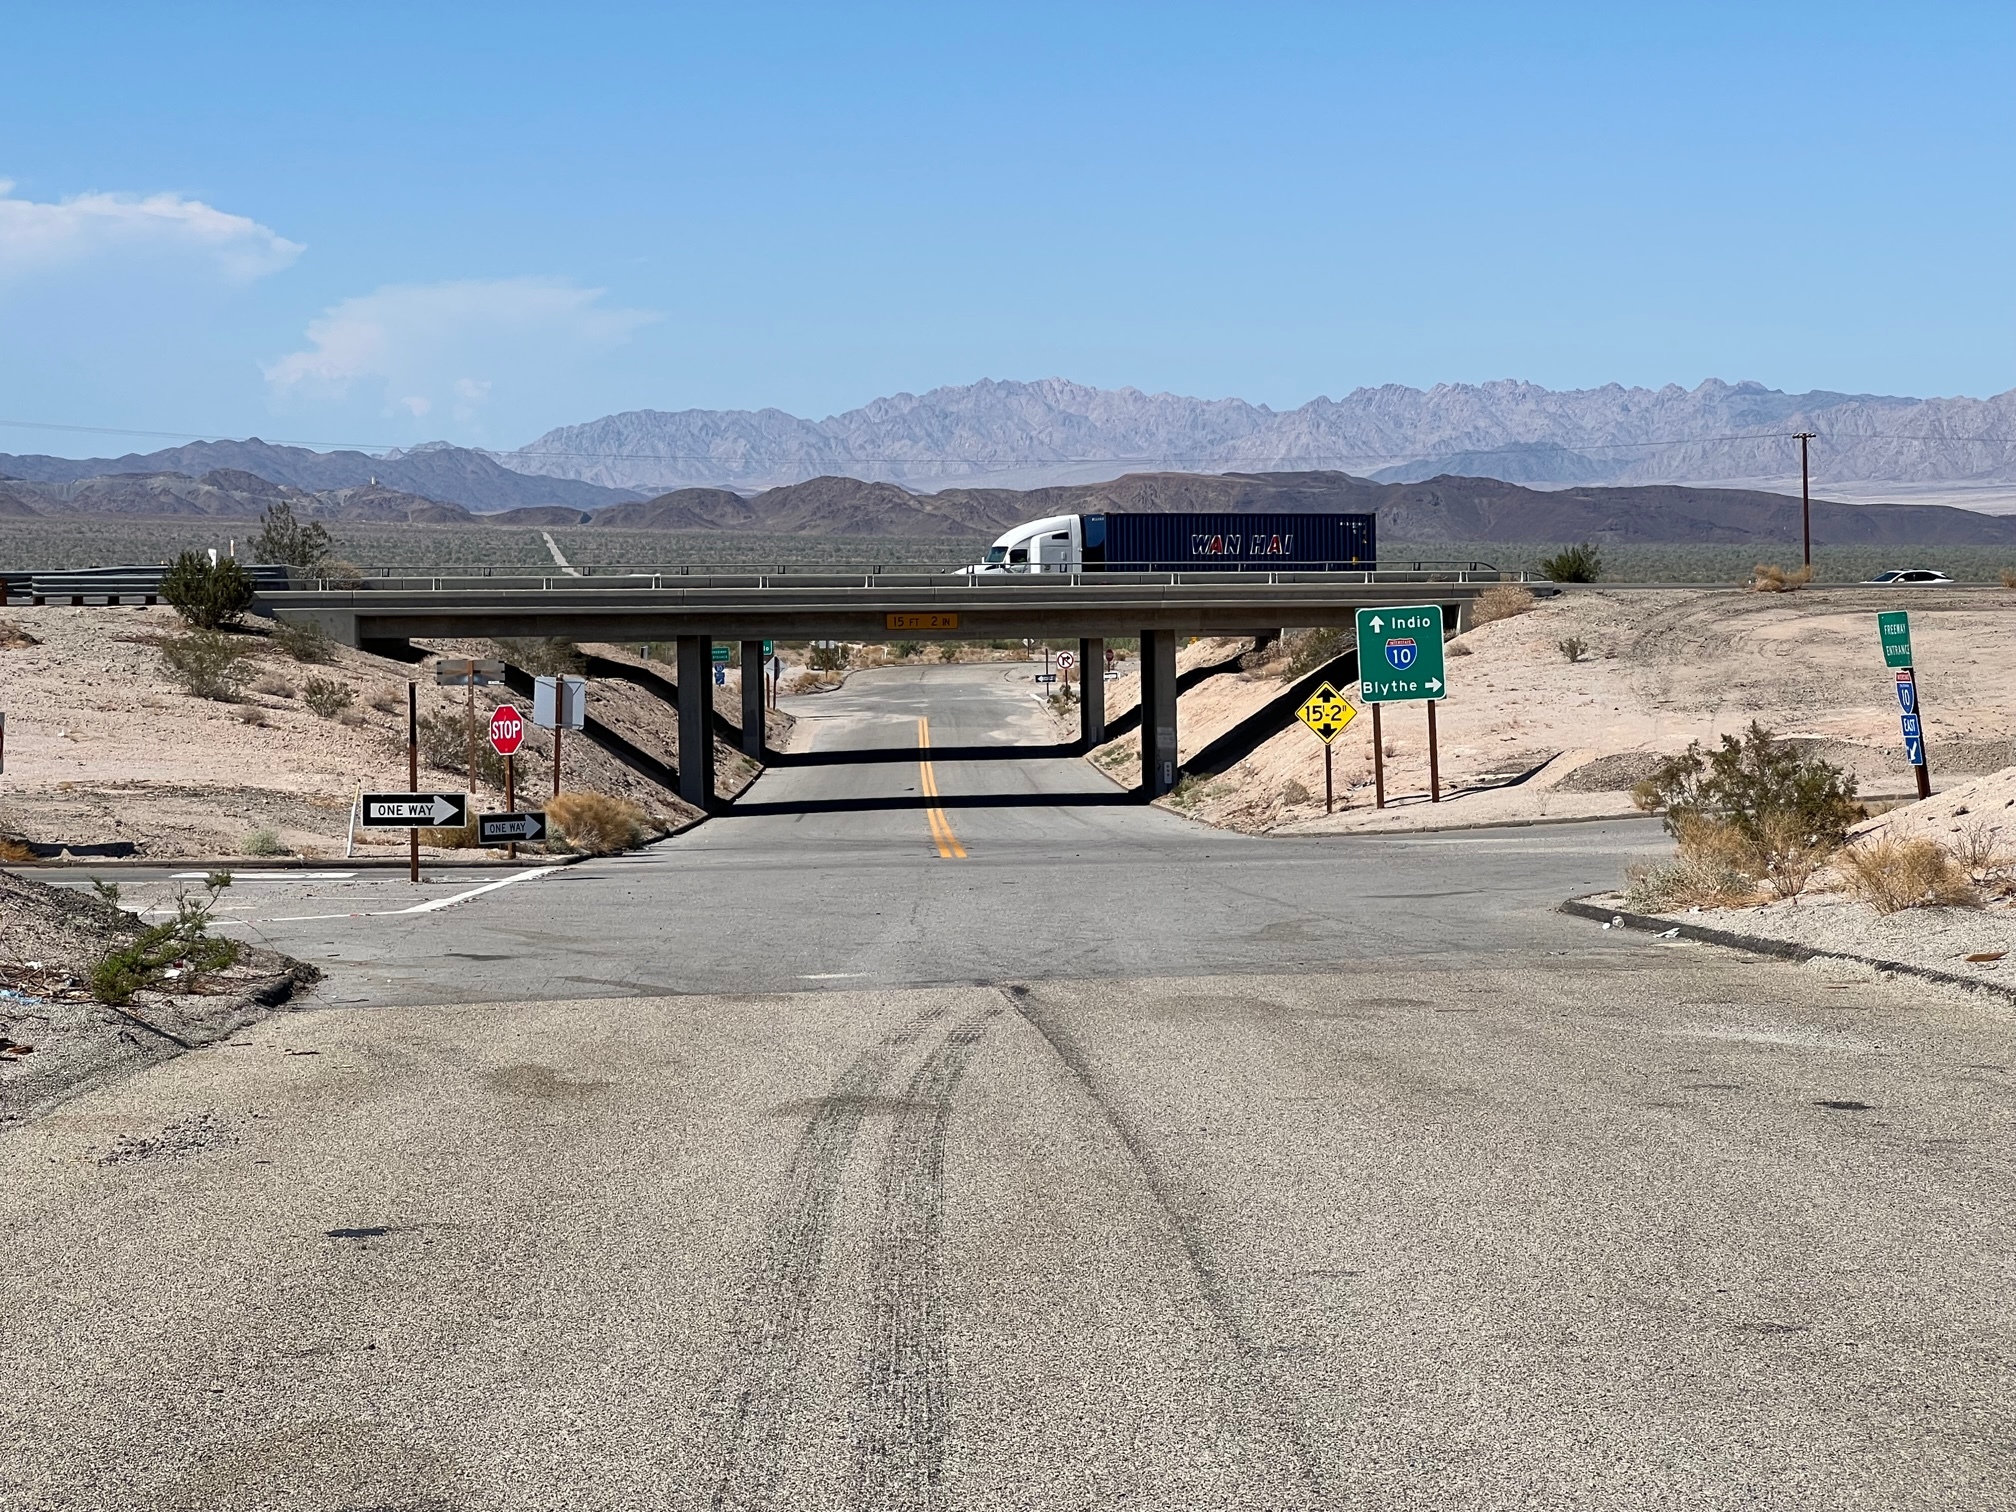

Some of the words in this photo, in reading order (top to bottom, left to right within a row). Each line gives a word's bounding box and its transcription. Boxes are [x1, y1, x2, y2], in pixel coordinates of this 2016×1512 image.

[1192, 534, 1241, 555] WAN
[1250, 534, 1293, 555] HAI
[893, 617, 904, 627] 15
[909, 618, 919, 627] FT
[931, 616, 938, 626] 2
[942, 618, 950, 626] IN
[1391, 615, 1431, 629] Indio
[1884, 623, 1906, 635] FREEWAY
[1392, 649, 1411, 664] 10
[1886, 644, 1910, 656] ENTRANCE
[1363, 681, 1417, 695] Blythe
[1901, 689, 1910, 706] 10
[492, 720, 521, 740] STOP
[1904, 718, 1916, 732] EAST
[378, 805, 403, 816] ONE
[408, 804, 434, 816] WAY
[489, 824, 507, 833] ONE
[509, 823, 526, 832] WAY
